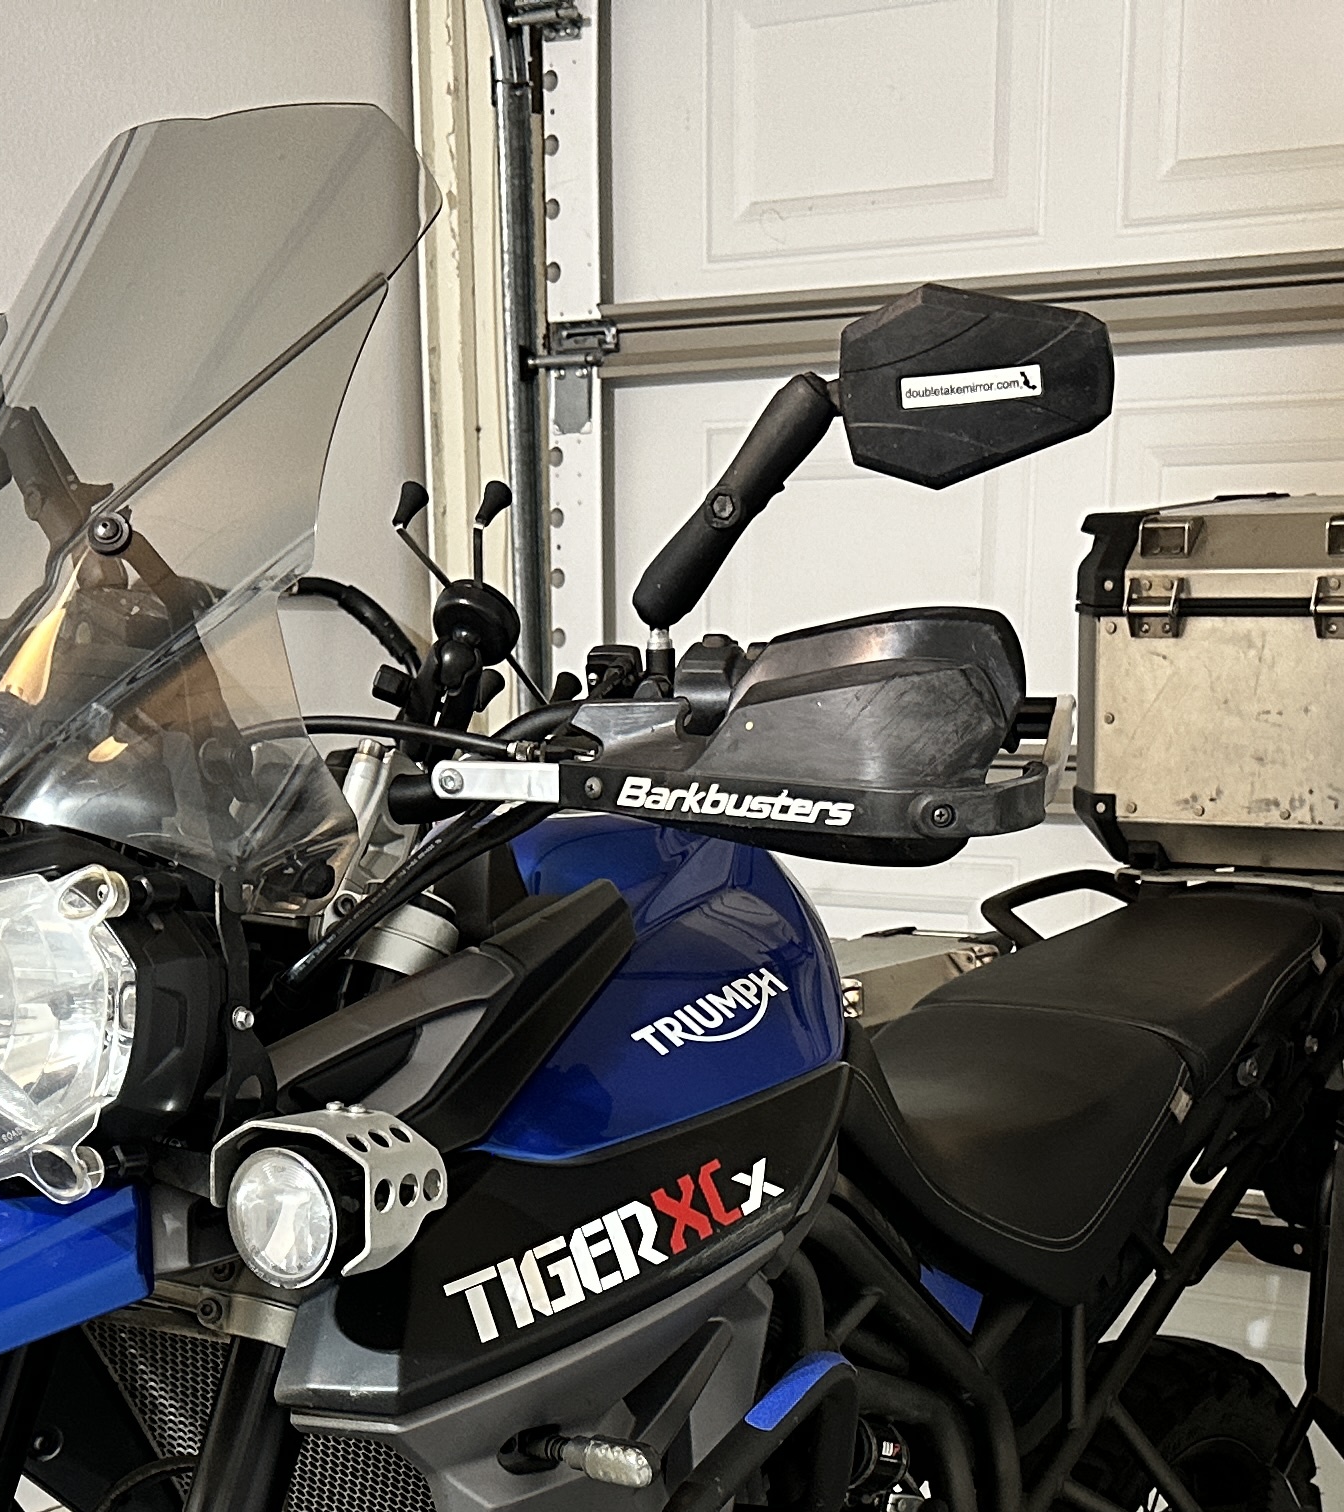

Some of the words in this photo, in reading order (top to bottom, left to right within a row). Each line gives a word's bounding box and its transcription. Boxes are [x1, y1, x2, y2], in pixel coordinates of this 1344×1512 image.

[617, 776, 854, 826] Barkbusters
[631, 967, 788, 1056] TRIUMPH
[443, 1199, 669, 1345] TIGER
